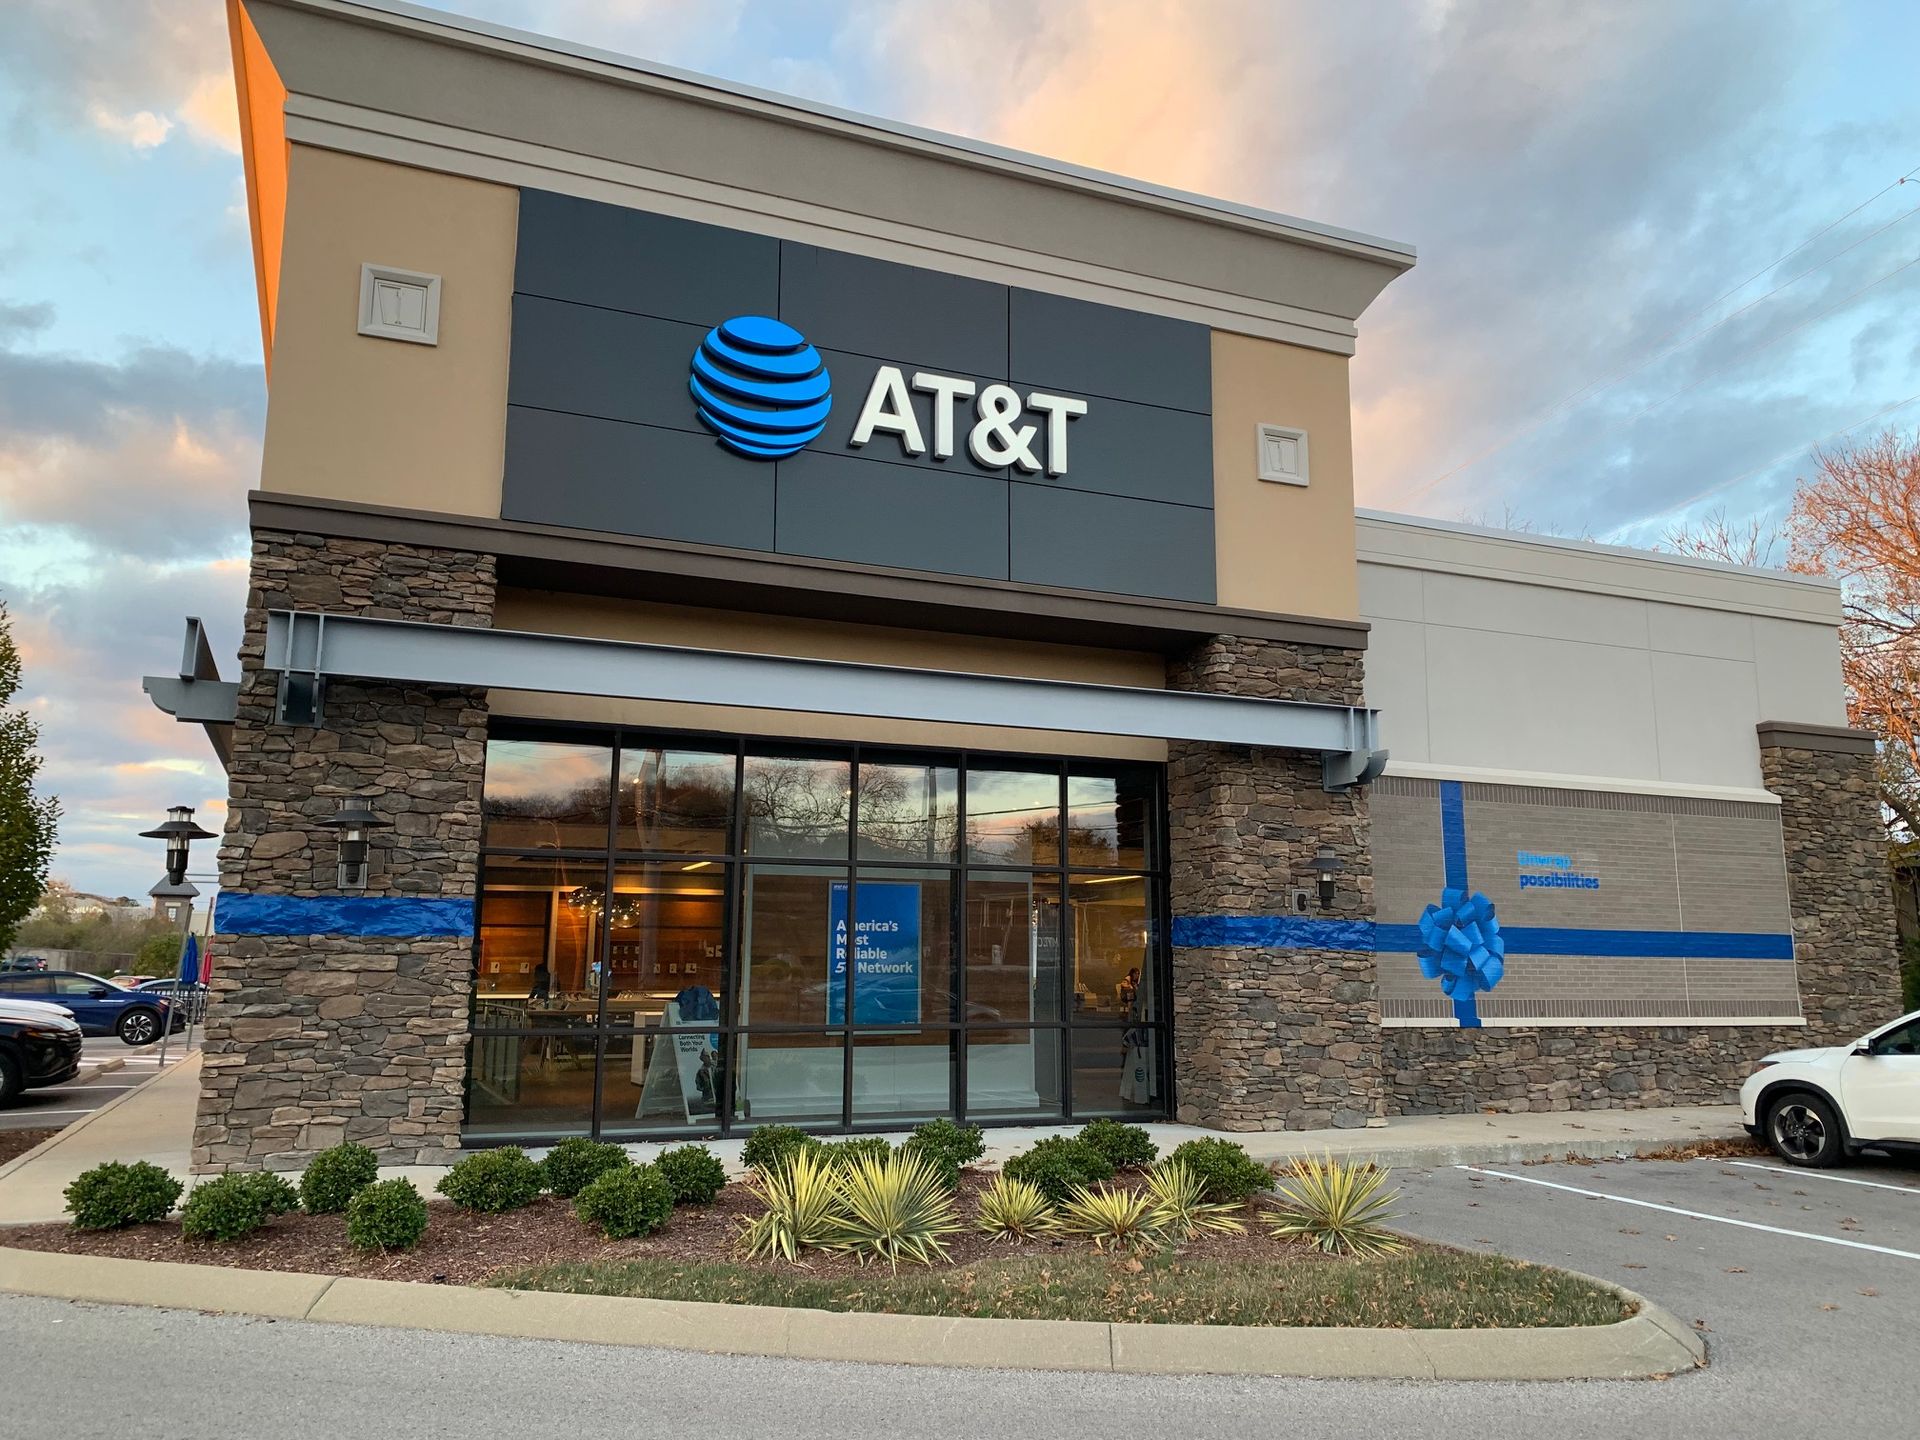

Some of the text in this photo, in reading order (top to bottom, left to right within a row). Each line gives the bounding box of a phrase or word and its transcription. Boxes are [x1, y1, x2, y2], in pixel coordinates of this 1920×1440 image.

[850, 365, 1088, 477] AT&T
[1520, 872, 1599, 890] possibilities
[836, 933, 869, 945] Mst
[836, 947, 887, 960] Rliable
[857, 961, 913, 974] Network
